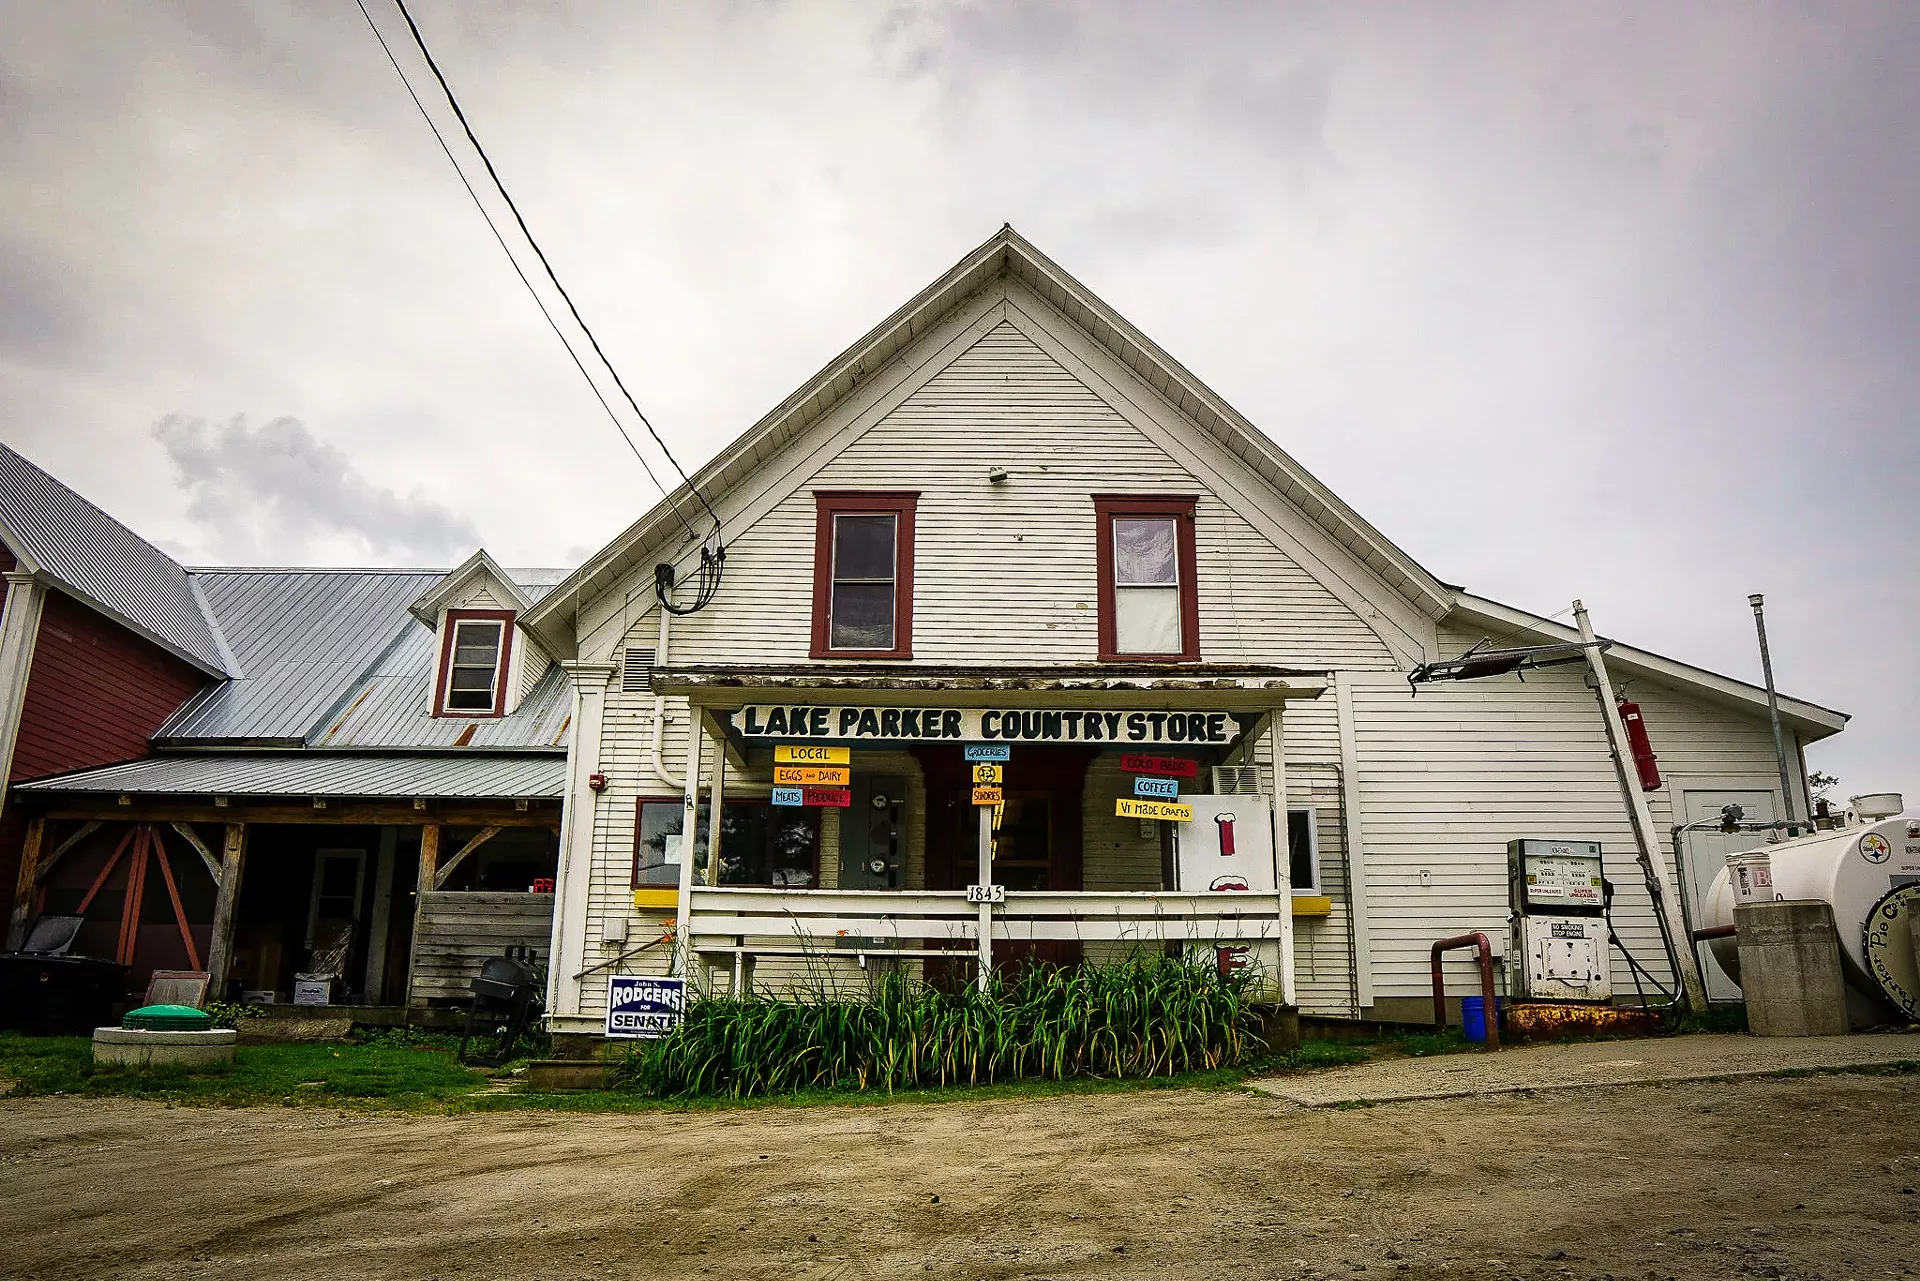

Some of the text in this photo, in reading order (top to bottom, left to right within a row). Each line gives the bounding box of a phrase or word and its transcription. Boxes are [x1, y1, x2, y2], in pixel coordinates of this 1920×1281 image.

[744, 706, 1227, 742] LAKE PARKER COUNTRY STORE
[968, 746, 1007, 758] GROCERIES
[1127, 757, 1186, 772] COLD BEER
[780, 769, 803, 782] EGGS
[818, 770, 842, 782] DAIRY
[1137, 781, 1173, 793] COFFEE
[775, 790, 801, 803] MEATS
[808, 791, 845, 803] PRODUCE
[973, 790, 1001, 801] SUNDRIES
[969, 885, 1002, 901] 1845
[1869, 922, 1889, 949] Pie
[612, 986, 681, 1011] RODGERS
[614, 1014, 677, 1029] SENATE
